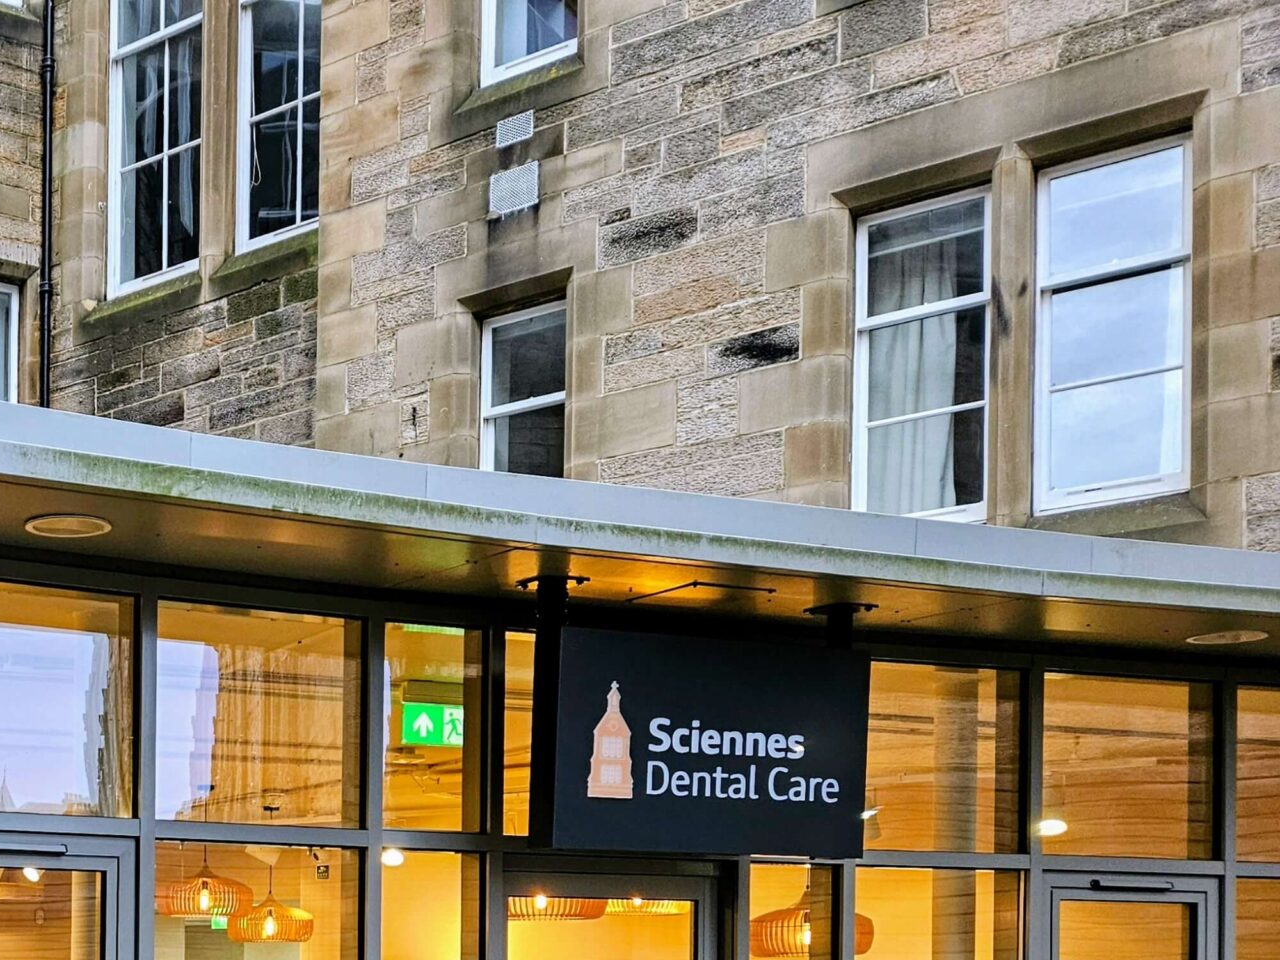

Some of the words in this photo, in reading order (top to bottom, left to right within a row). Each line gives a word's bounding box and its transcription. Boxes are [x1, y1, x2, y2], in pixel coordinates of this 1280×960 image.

[648, 716, 805, 759] Sciennes
[646, 760, 759, 800] Dental
[768, 765, 840, 803] Care
